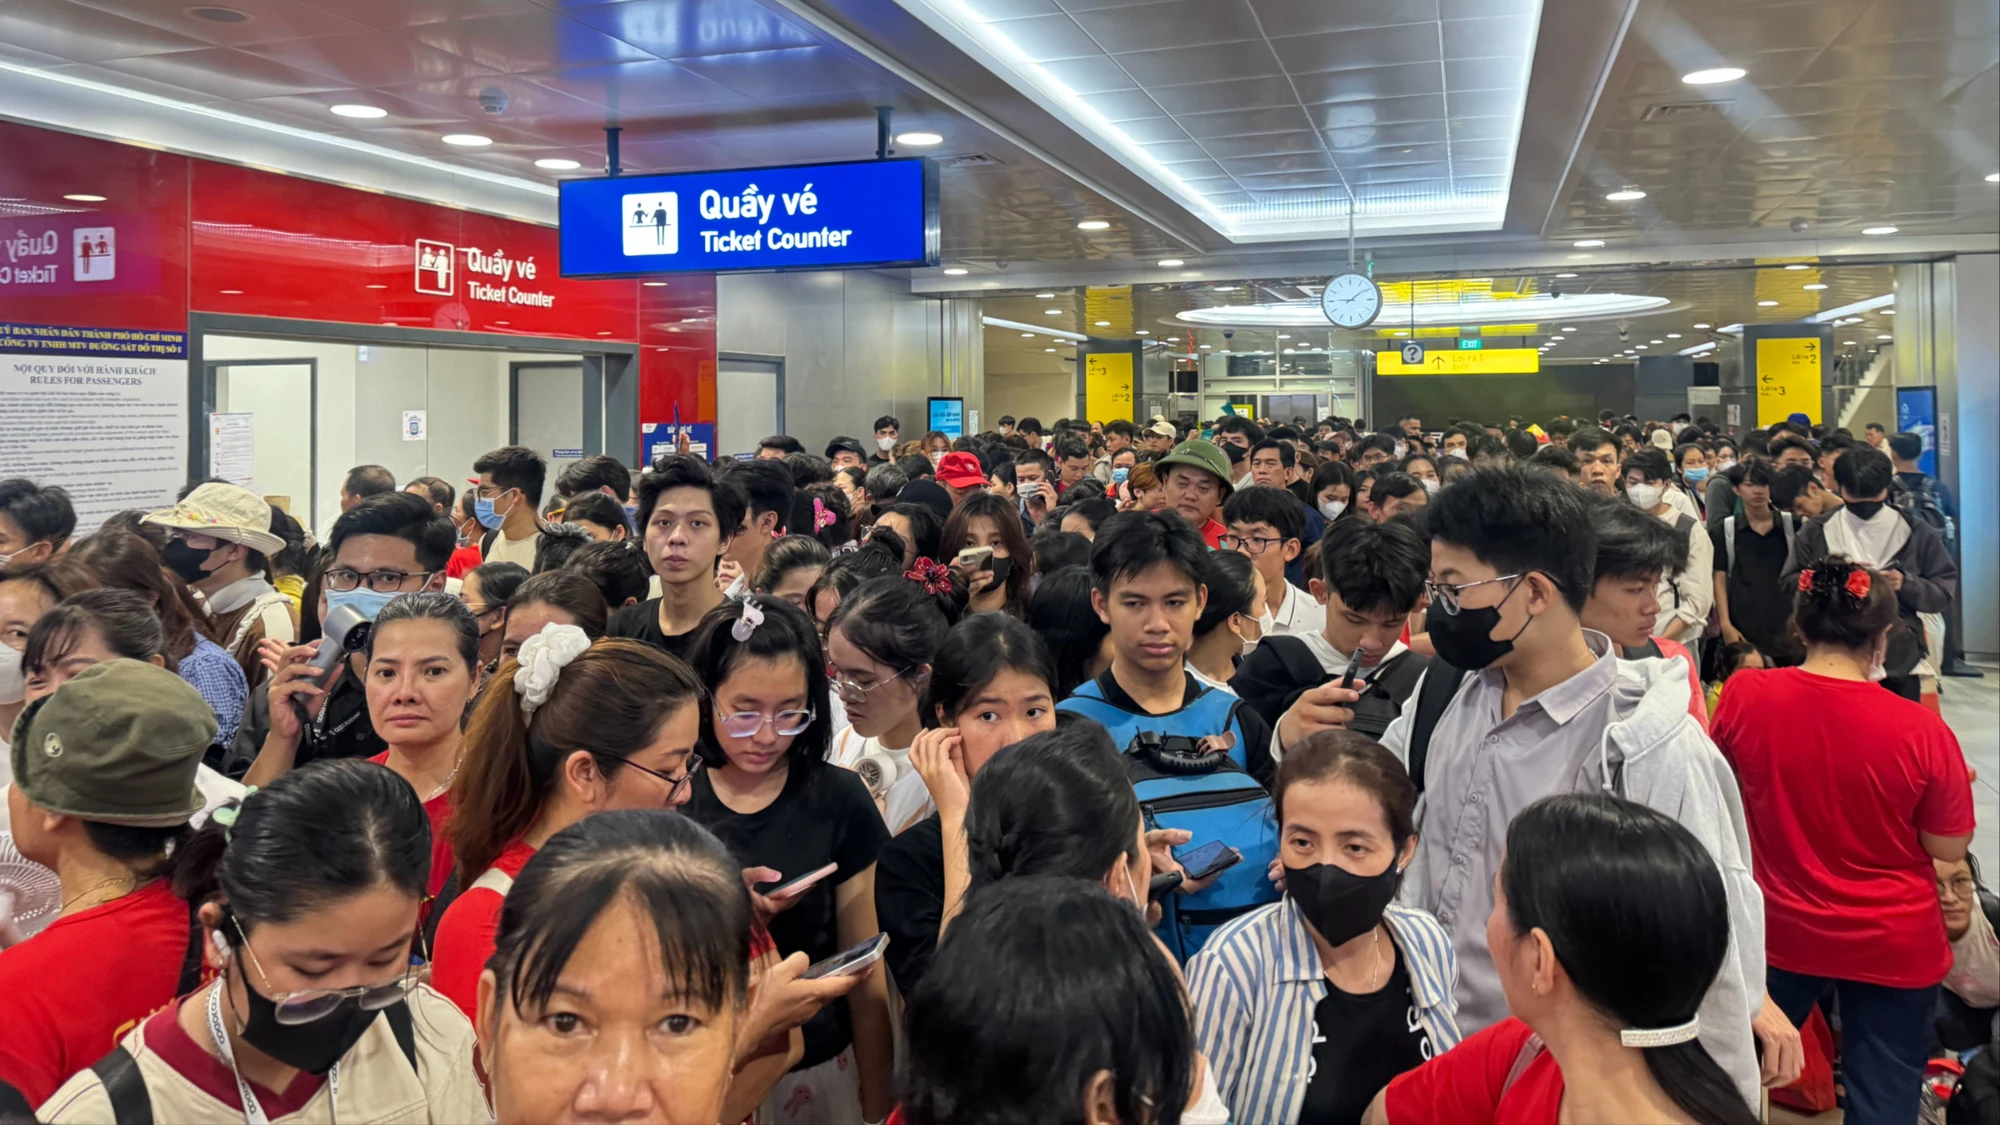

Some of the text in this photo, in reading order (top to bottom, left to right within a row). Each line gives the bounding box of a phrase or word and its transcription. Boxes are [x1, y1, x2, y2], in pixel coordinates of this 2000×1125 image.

[700, 183, 818, 225] Quầy vé
[700, 226, 853, 253] Ticket Counter
[467, 247, 536, 282] Quầy vé
[467, 281, 556, 308] Ticket Counter
[13, 326, 33, 336] BAN
[161, 334, 183, 343] MINH
[27, 339, 39, 348] TY
[42, 340, 67, 349] TNHH
[68, 341, 88, 350] MTV
[1462, 339, 1478, 349] EXIT
[1809, 354, 1817, 364] 2
[34, 364, 54, 375] QUY
[1101, 366, 1107, 376] 3
[30, 375, 142, 386] RULES FOR PASSENGERS
[1778, 386, 1786, 396] 3
[1124, 393, 1130, 402] 2
